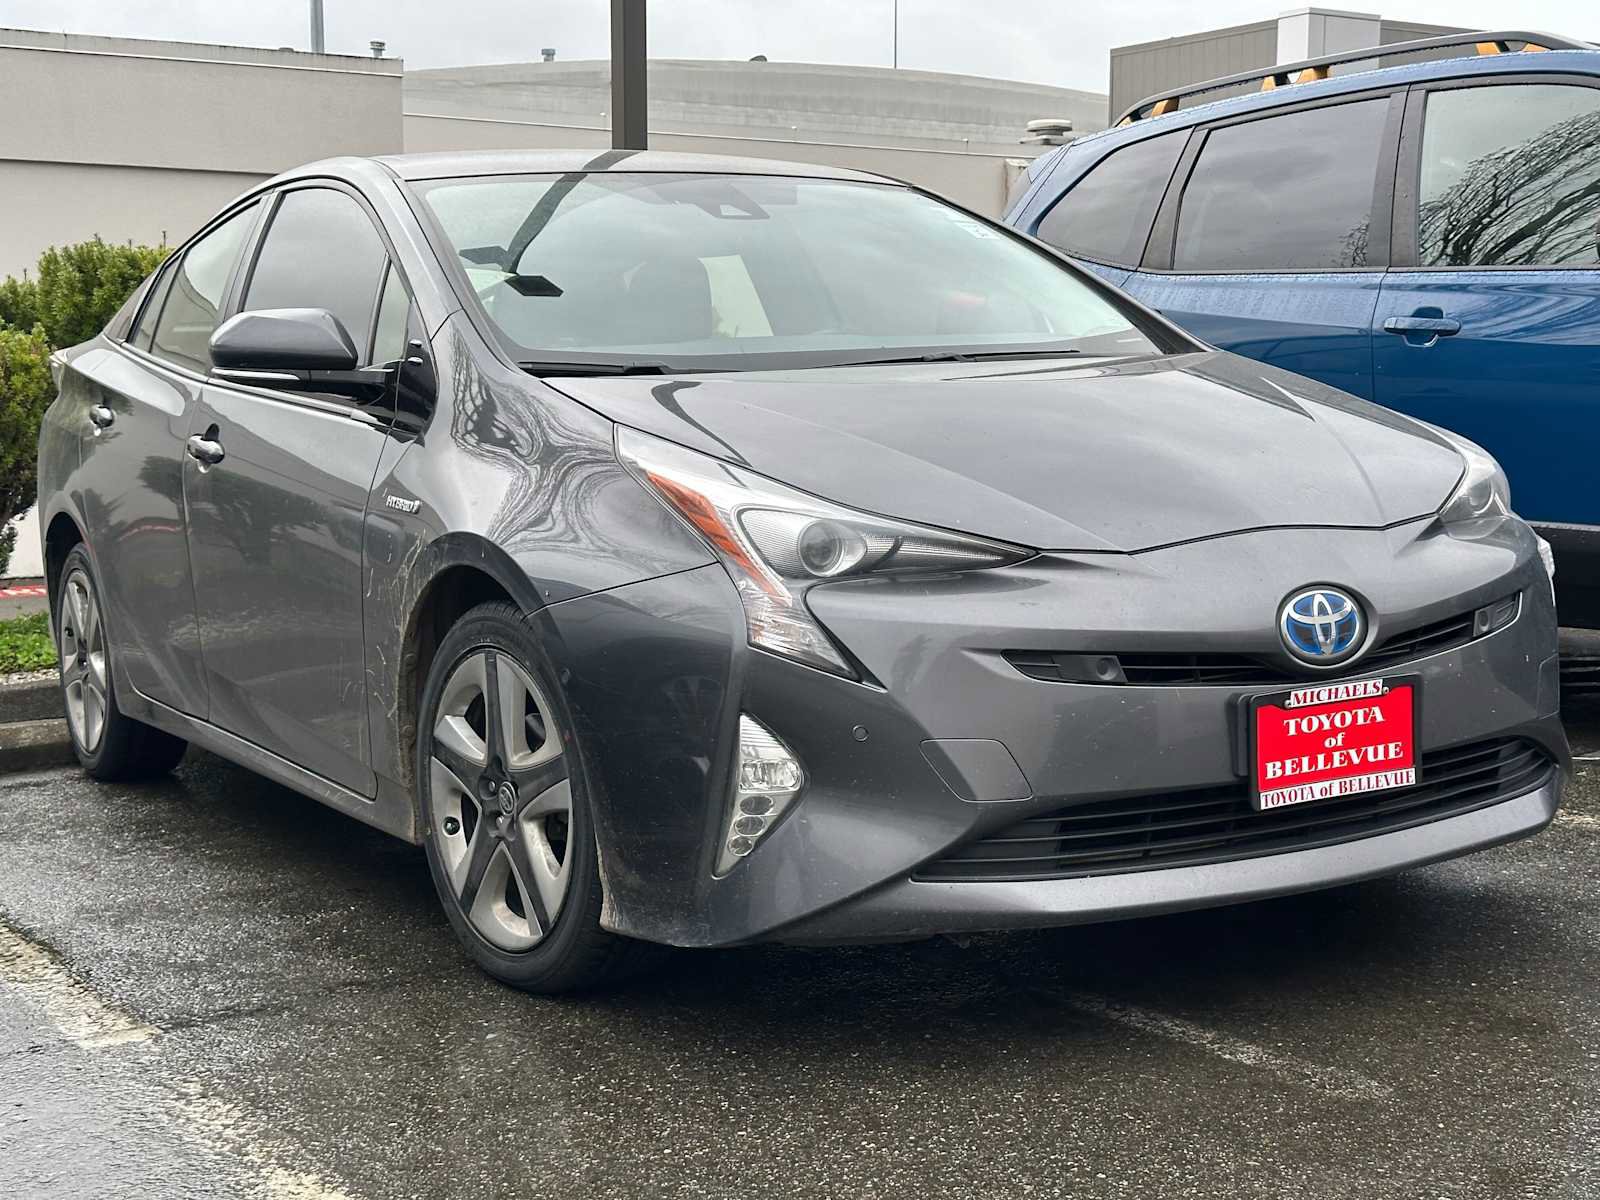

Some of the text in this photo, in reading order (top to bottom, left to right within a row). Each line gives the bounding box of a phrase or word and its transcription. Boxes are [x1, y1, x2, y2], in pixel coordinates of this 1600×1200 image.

[1292, 681, 1381, 705] MICHAELS
[1284, 706, 1384, 736] TOYOTA
[1324, 732, 1345, 748] of
[1265, 742, 1403, 779] BELLEVUE
[1261, 769, 1414, 808] TOYOTA of BELLEVUE
